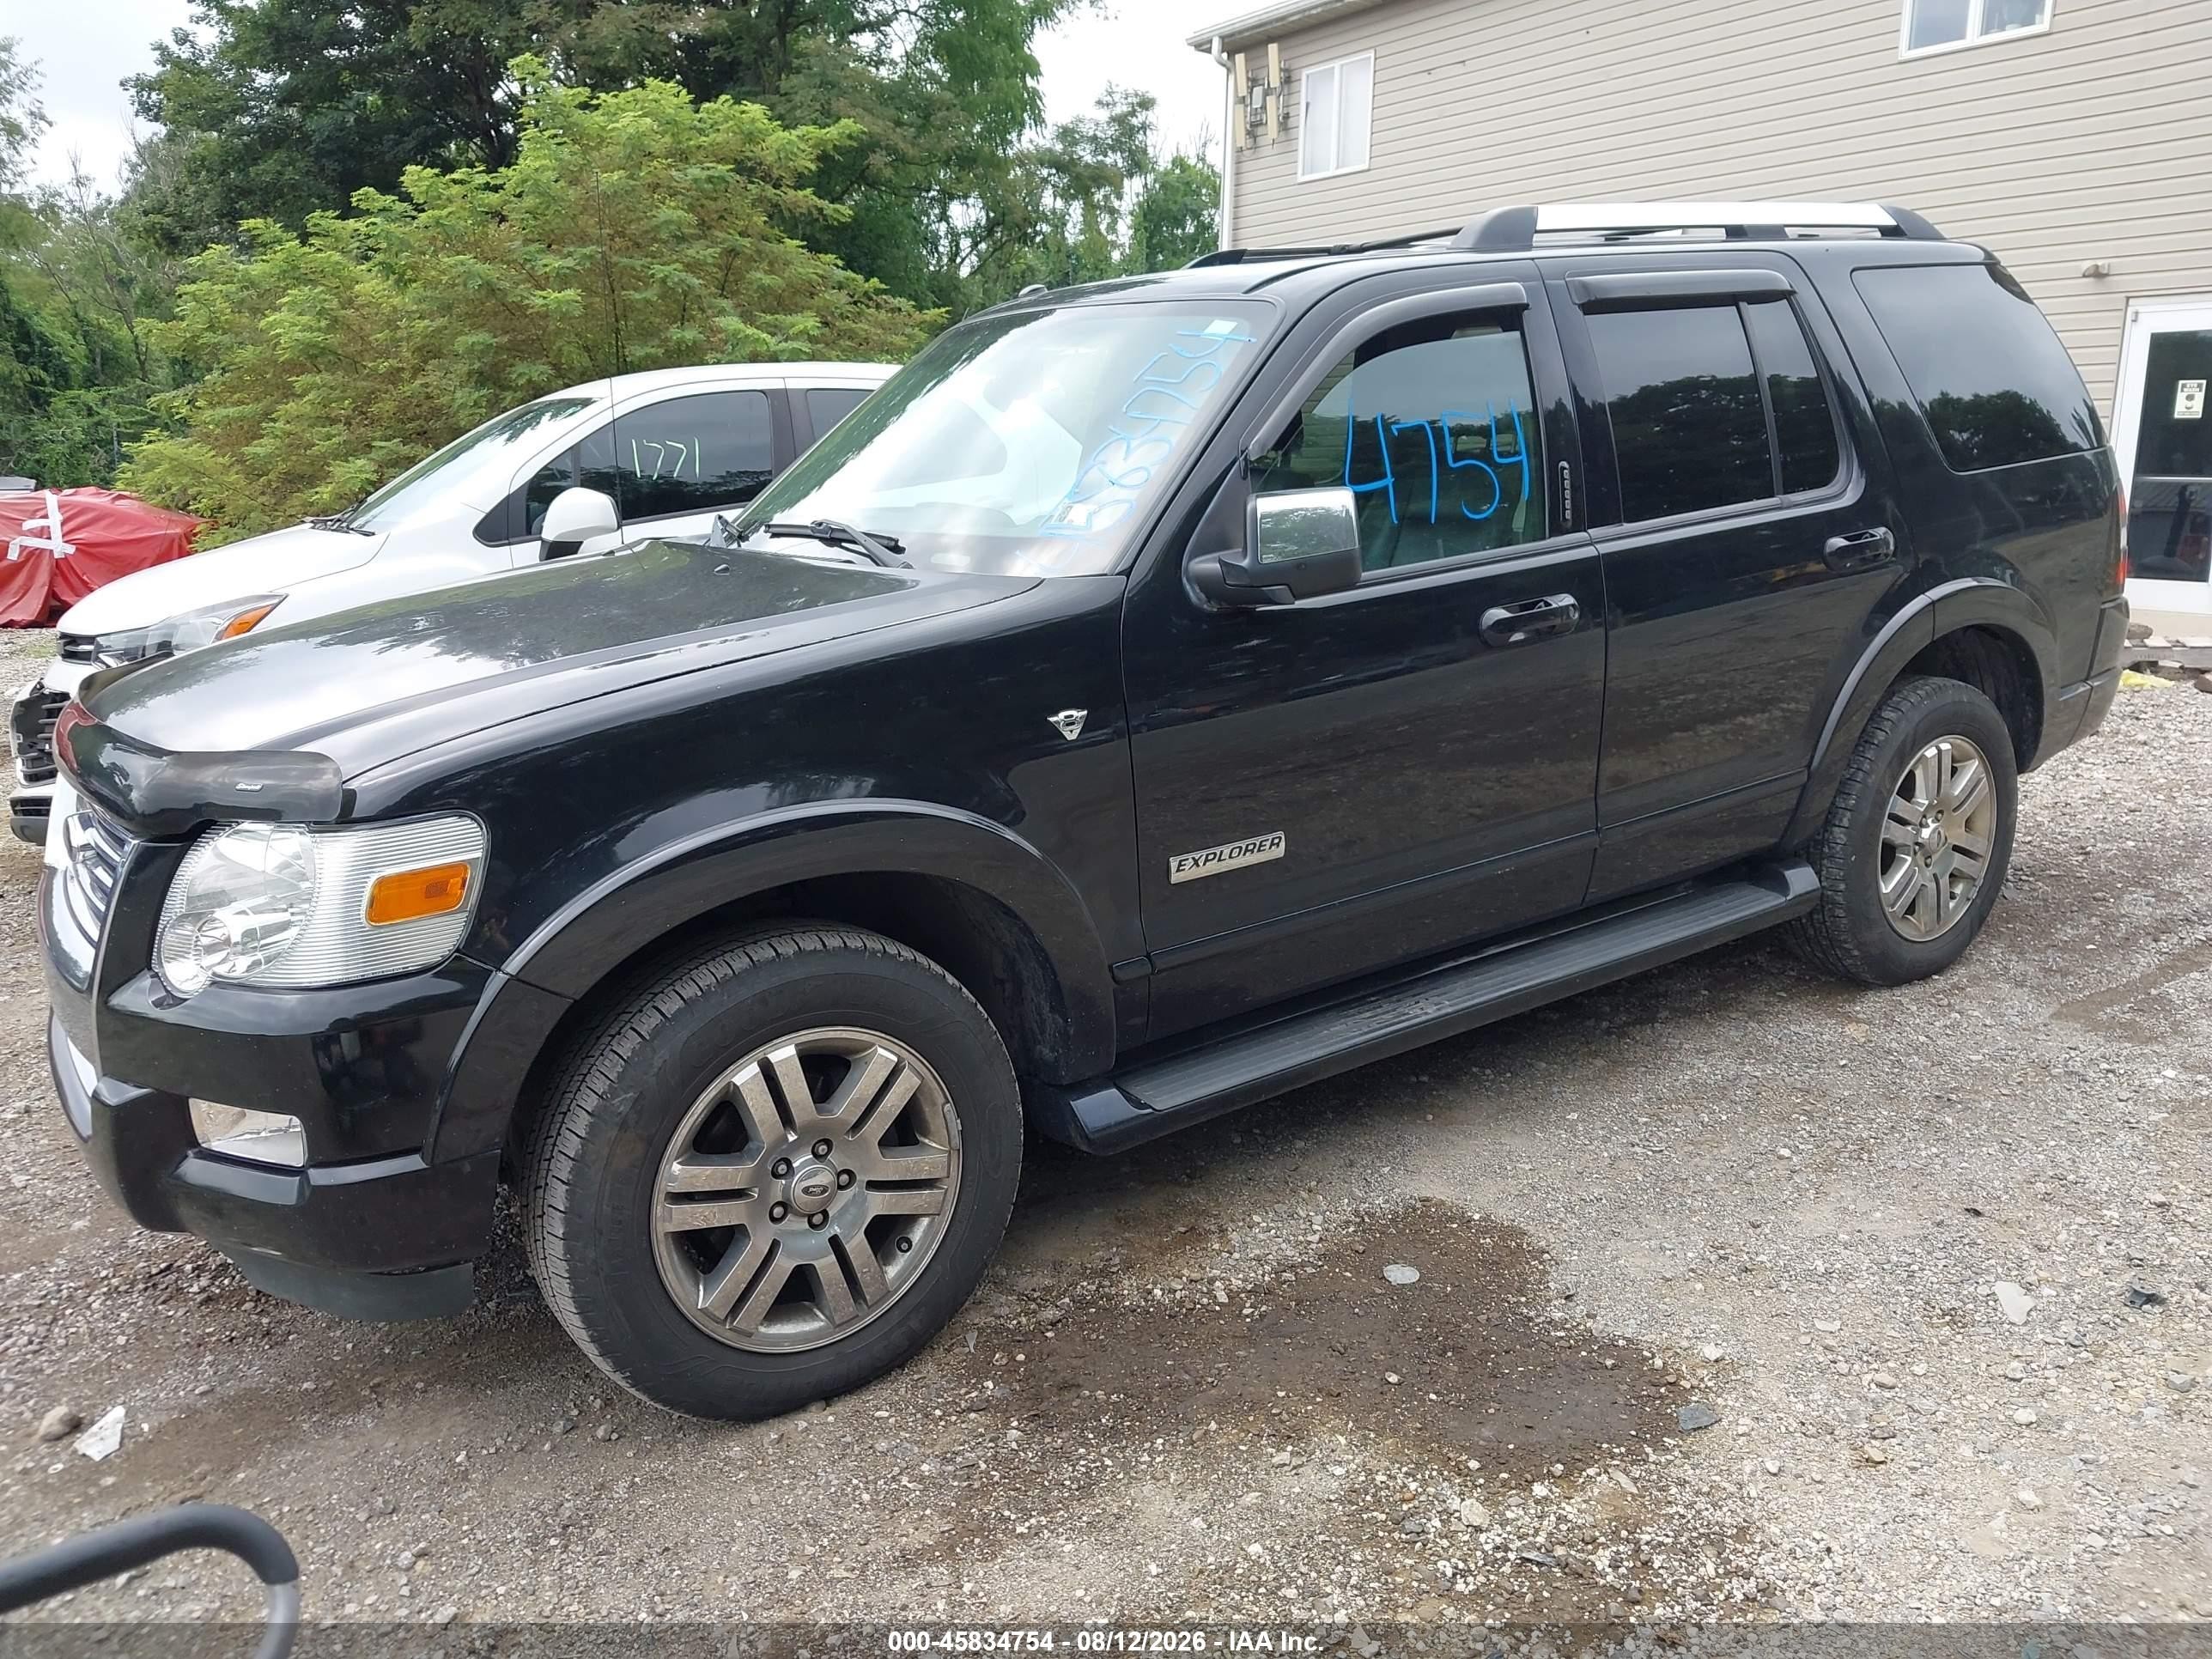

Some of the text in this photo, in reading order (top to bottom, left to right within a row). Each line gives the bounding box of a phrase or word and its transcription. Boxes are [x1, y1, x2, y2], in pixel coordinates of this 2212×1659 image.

[631, 435, 700, 481] 1771
[1344, 392, 1530, 525] 4754
[1175, 836, 1283, 873] EXPLORER
